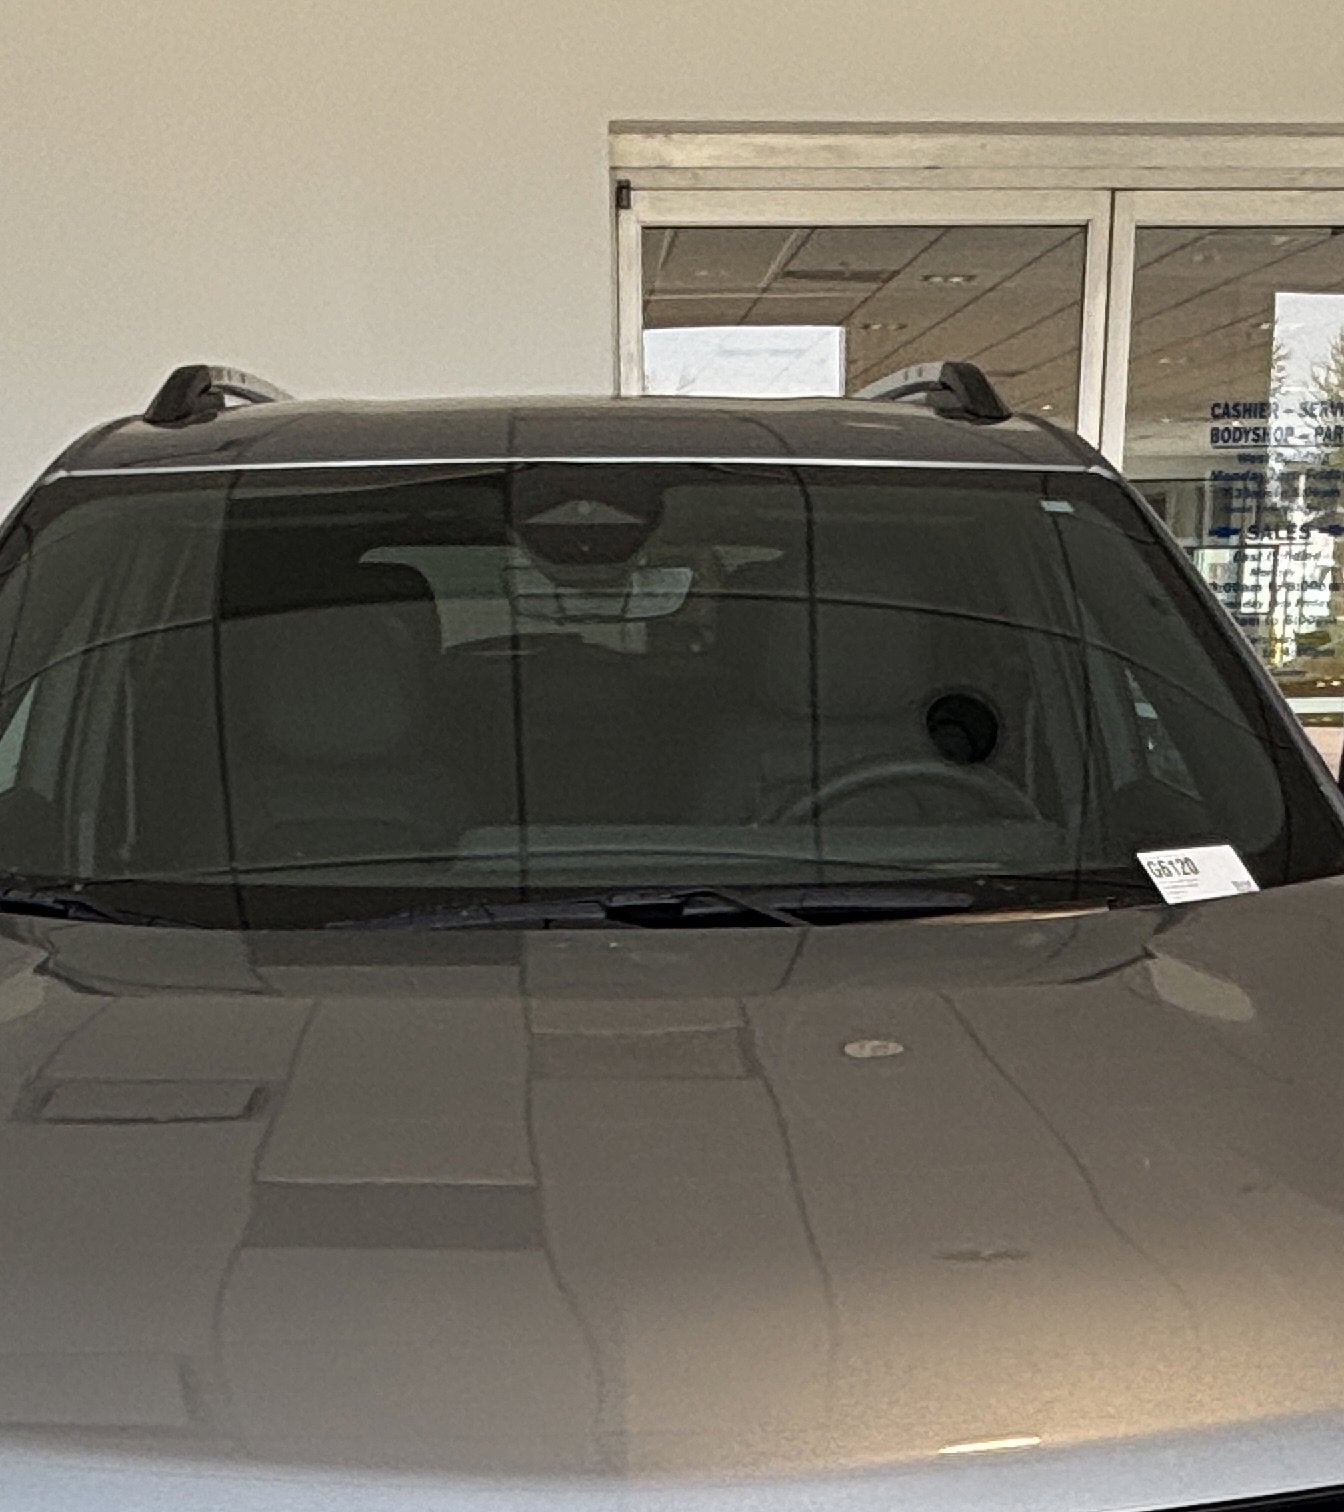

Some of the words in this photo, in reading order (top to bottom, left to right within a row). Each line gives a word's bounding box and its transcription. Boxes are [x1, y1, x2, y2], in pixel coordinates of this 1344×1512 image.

[1211, 402, 1280, 419] CASHIER
[1211, 426, 1295, 443] BODYSHOP
[1247, 523, 1311, 540] SALES
[1147, 857, 1199, 878] G6120
